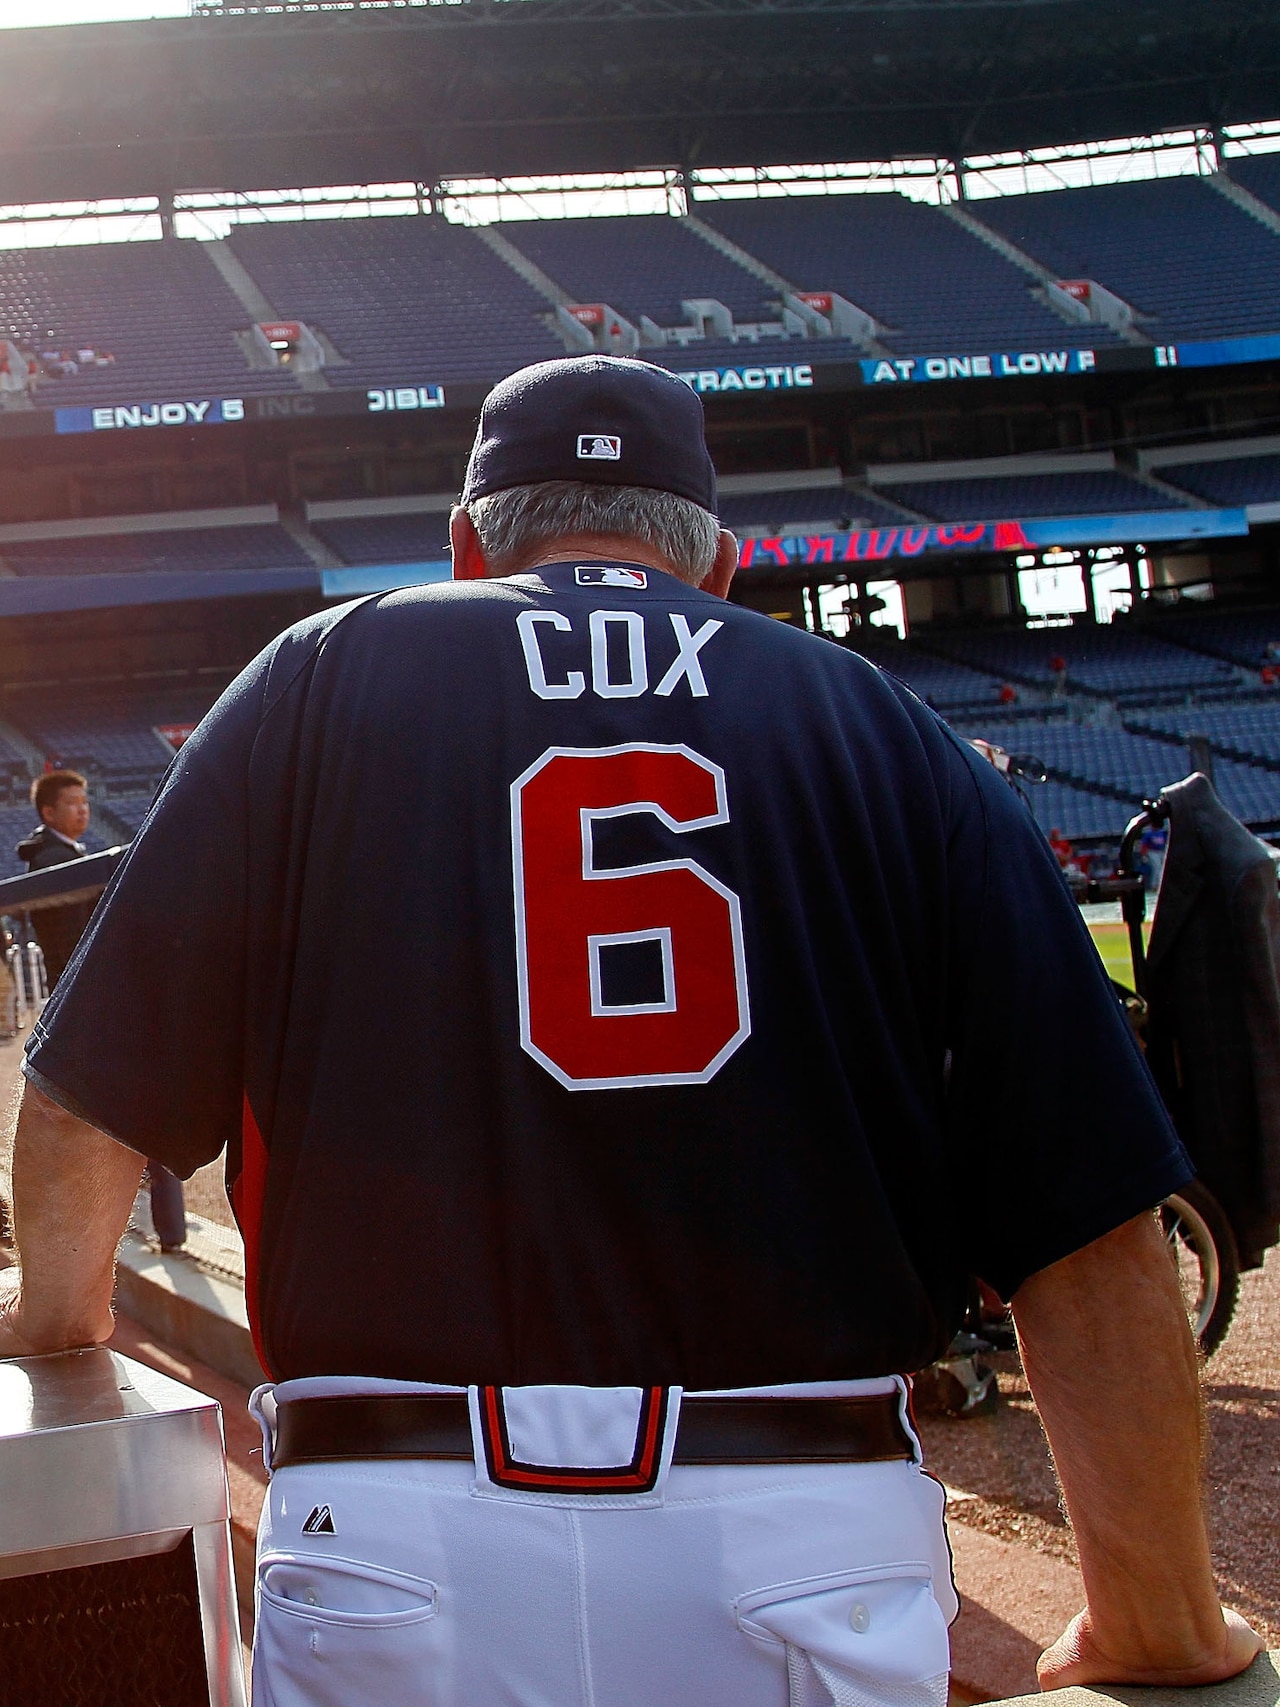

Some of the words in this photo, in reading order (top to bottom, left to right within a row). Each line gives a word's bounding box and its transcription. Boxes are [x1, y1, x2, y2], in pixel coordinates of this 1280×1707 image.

[874, 359, 915, 382] AT
[924, 356, 992, 380] ONE
[1000, 351, 1068, 376] LOW
[92, 400, 211, 430] ENJOY
[221, 398, 245, 422] 5
[516, 609, 725, 700] COX
[510, 741, 752, 1092] 6
